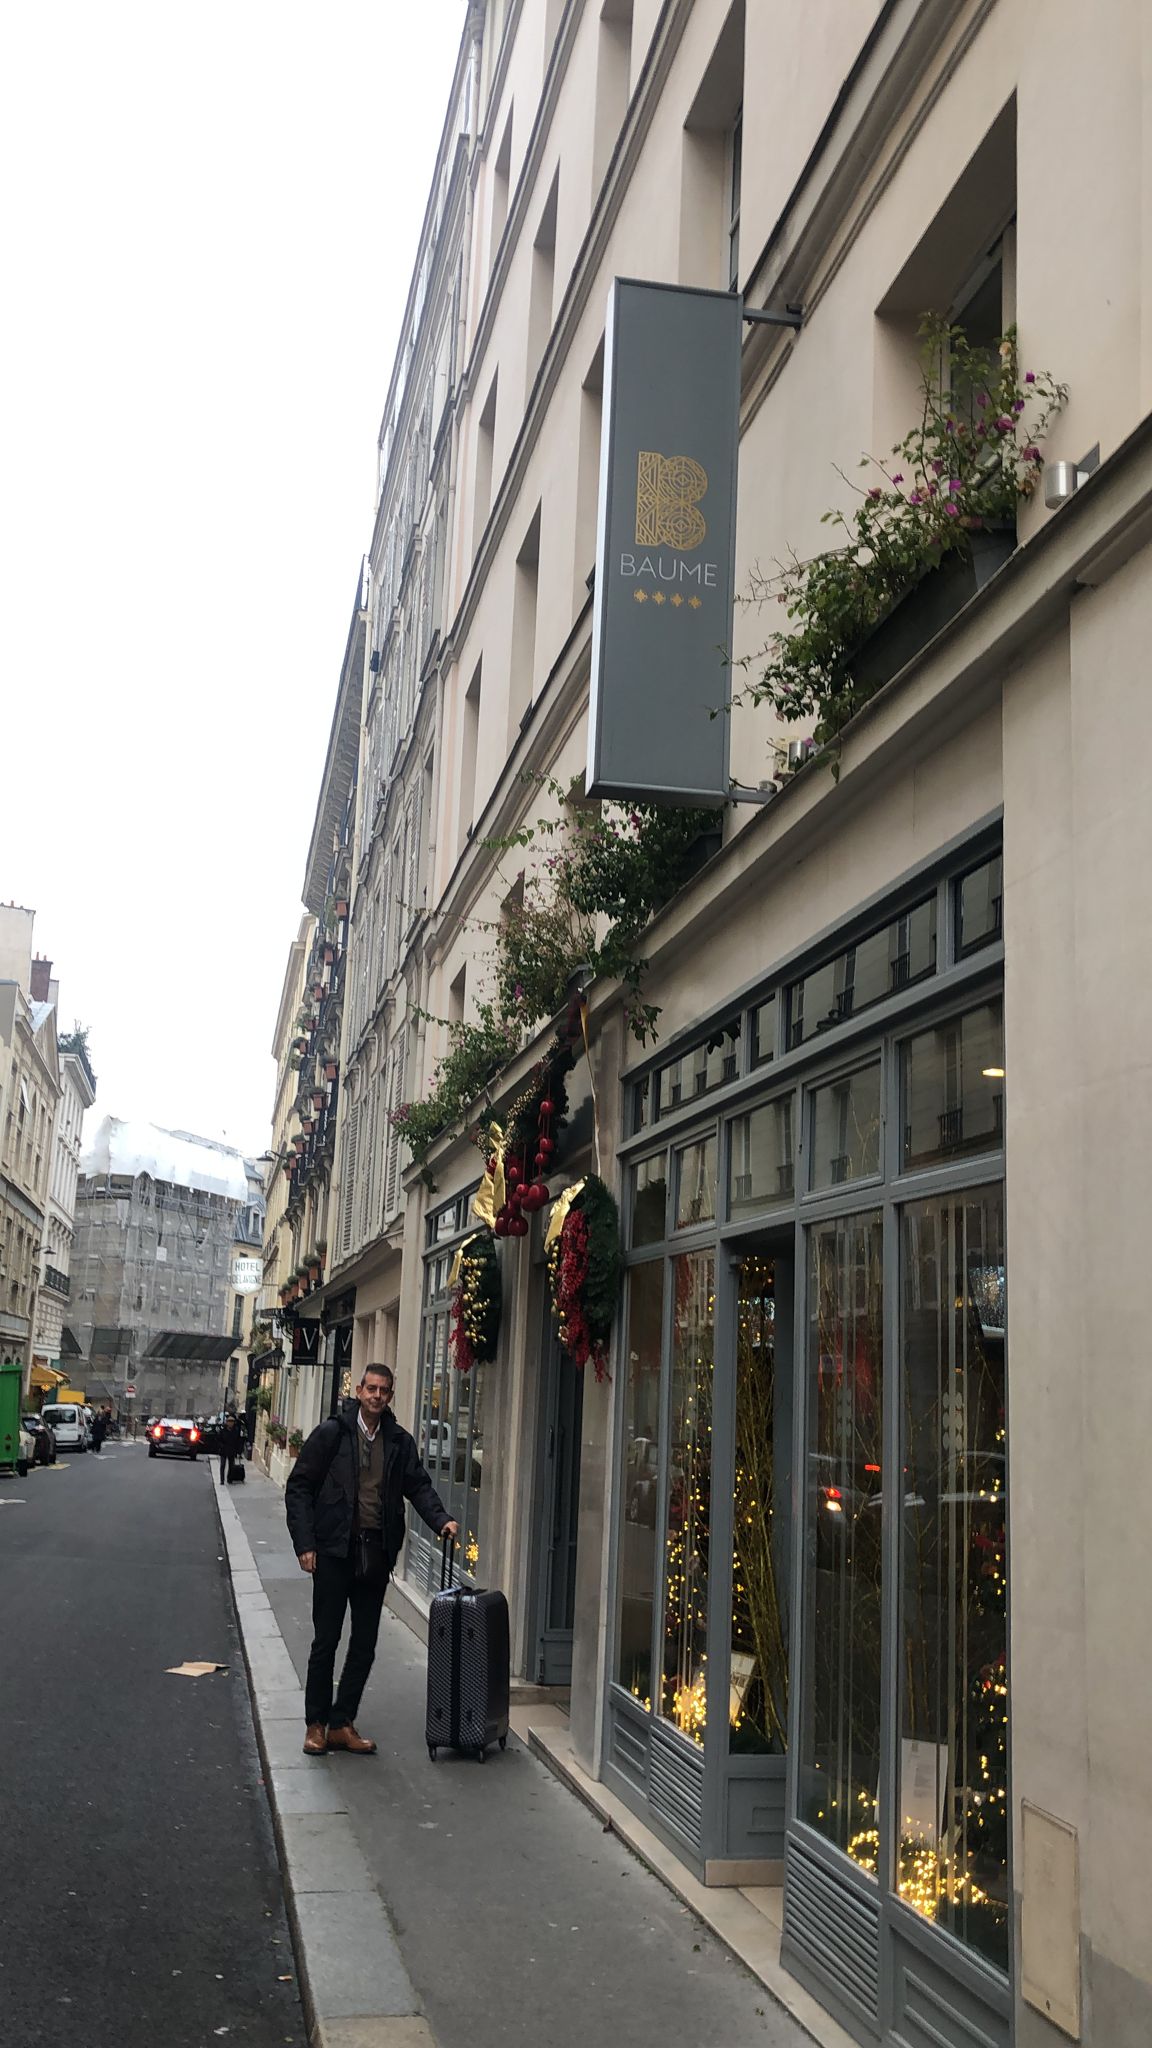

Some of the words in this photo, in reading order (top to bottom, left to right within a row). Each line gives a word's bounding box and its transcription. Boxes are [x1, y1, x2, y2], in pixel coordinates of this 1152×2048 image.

[620, 553, 718, 587] BAUME
[235, 1262, 260, 1272] HOTEL
[302, 1327, 317, 1351] V
